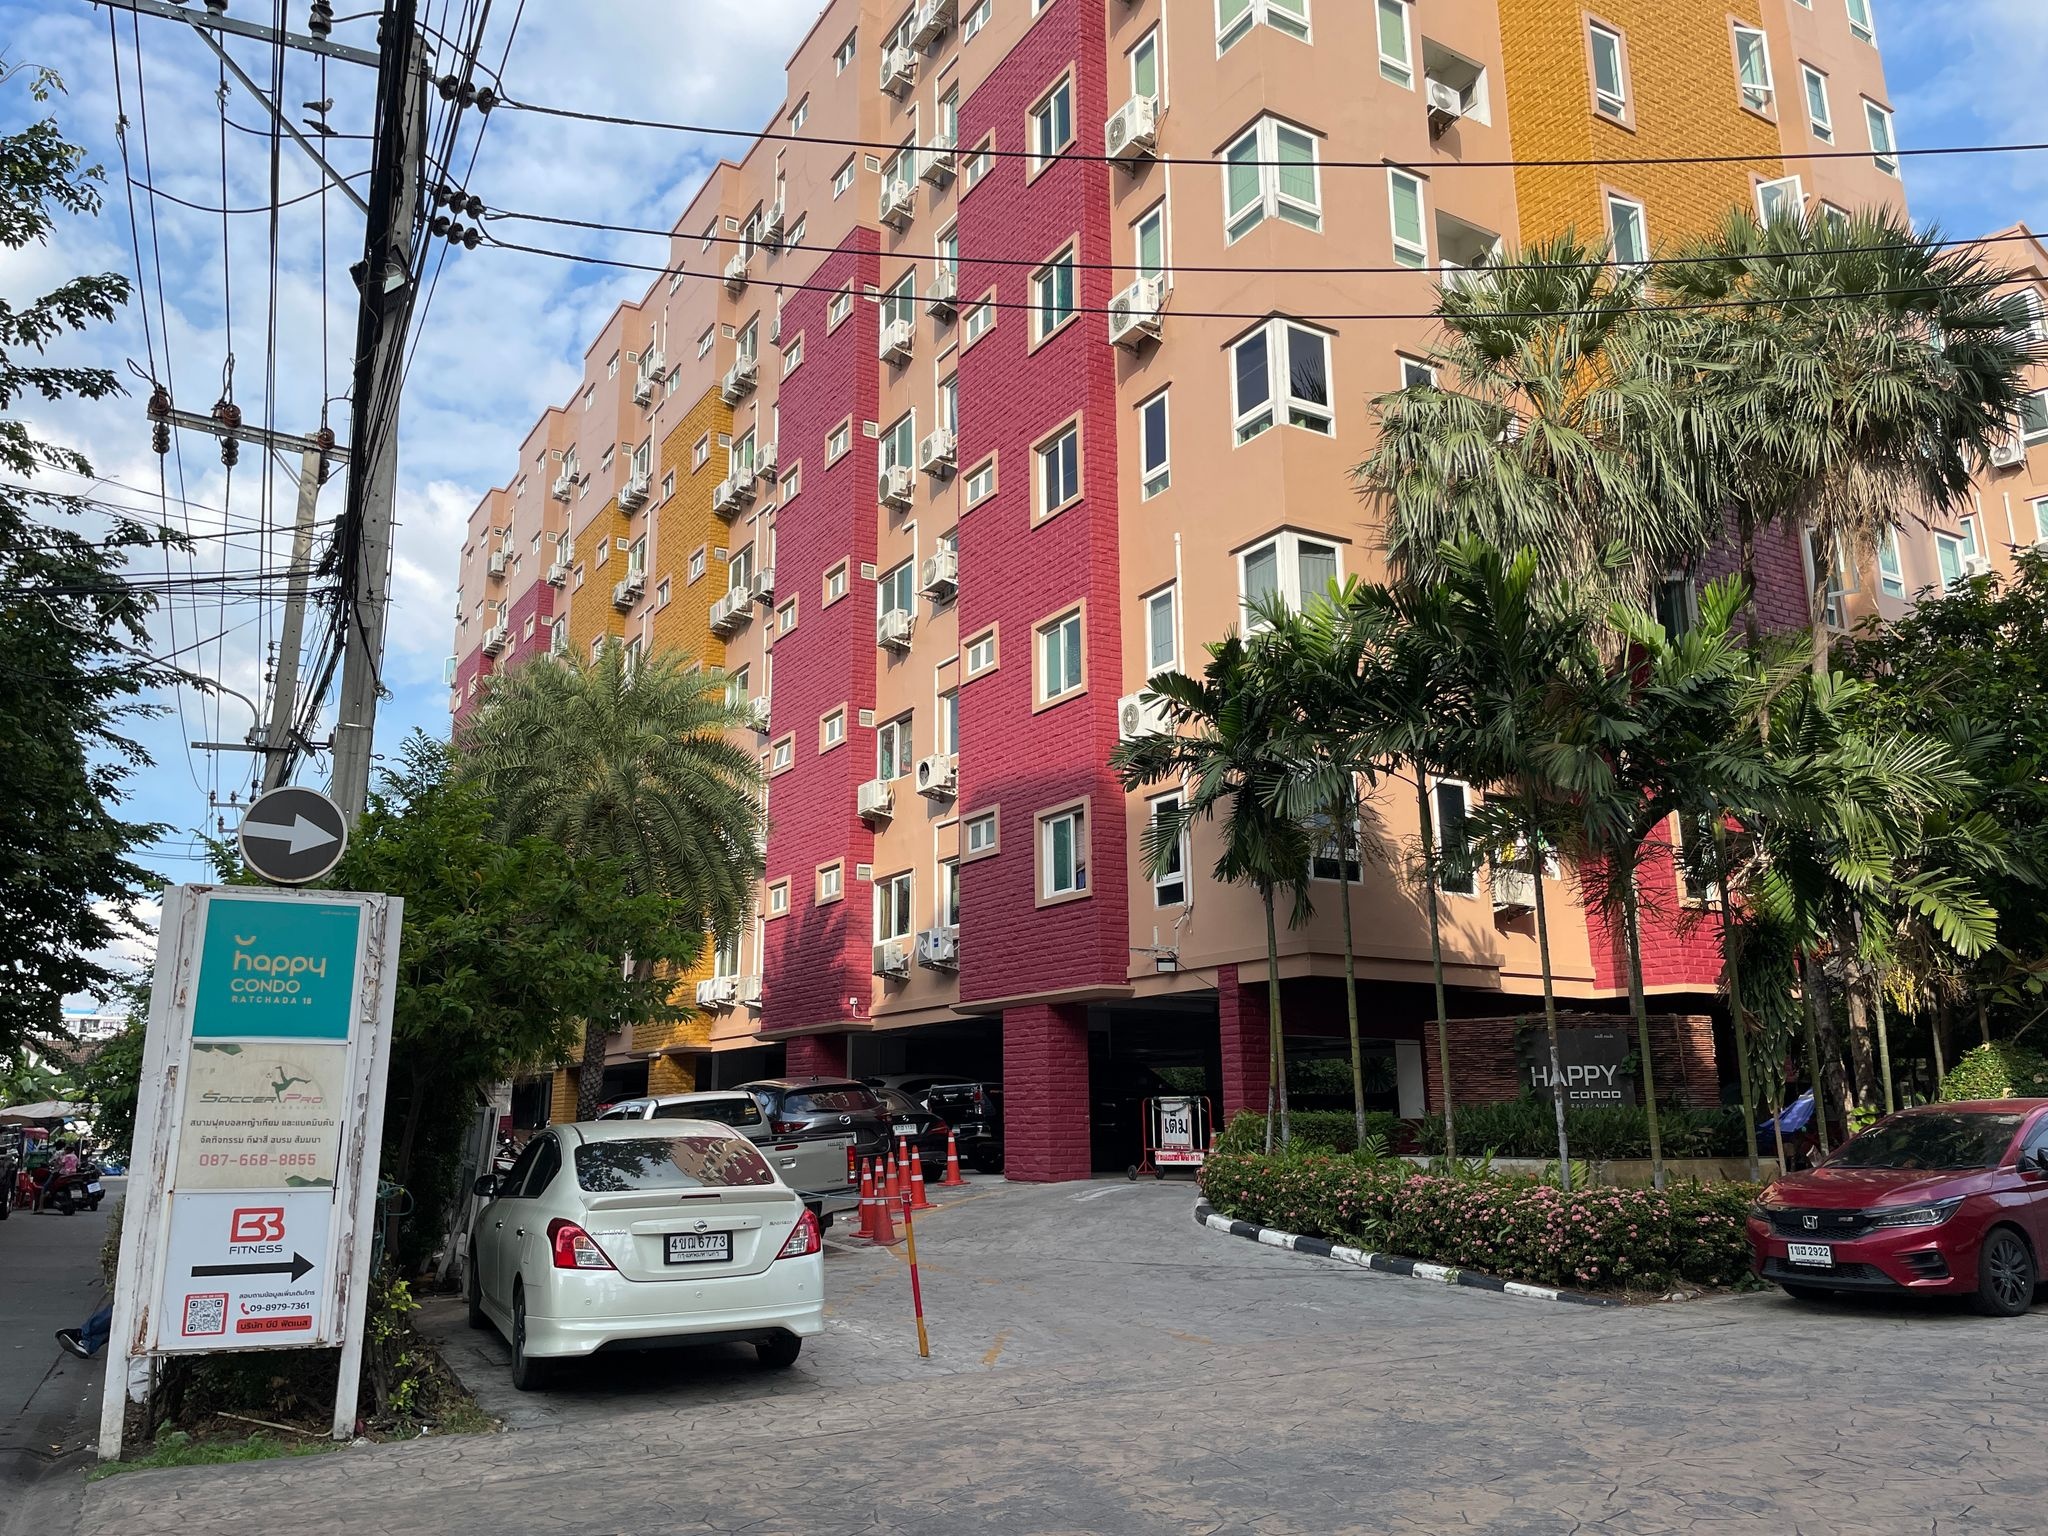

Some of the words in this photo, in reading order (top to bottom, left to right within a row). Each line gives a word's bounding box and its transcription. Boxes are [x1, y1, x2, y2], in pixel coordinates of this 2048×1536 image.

[232, 949, 327, 978] happy
[230, 978, 301, 993] CONDO
[231, 995, 297, 1005] RATCHADA
[1530, 1064, 1617, 1087] HAPPY
[1164, 1111, 1188, 1134] เต็ม
[199, 1153, 317, 1167] 087-668-8855
[698, 1236, 726, 1249] 6773
[229, 1244, 283, 1255] FITNESS
[1808, 1246, 1829, 1257] 2922
[249, 1302, 310, 1313] 09-8979-7361
